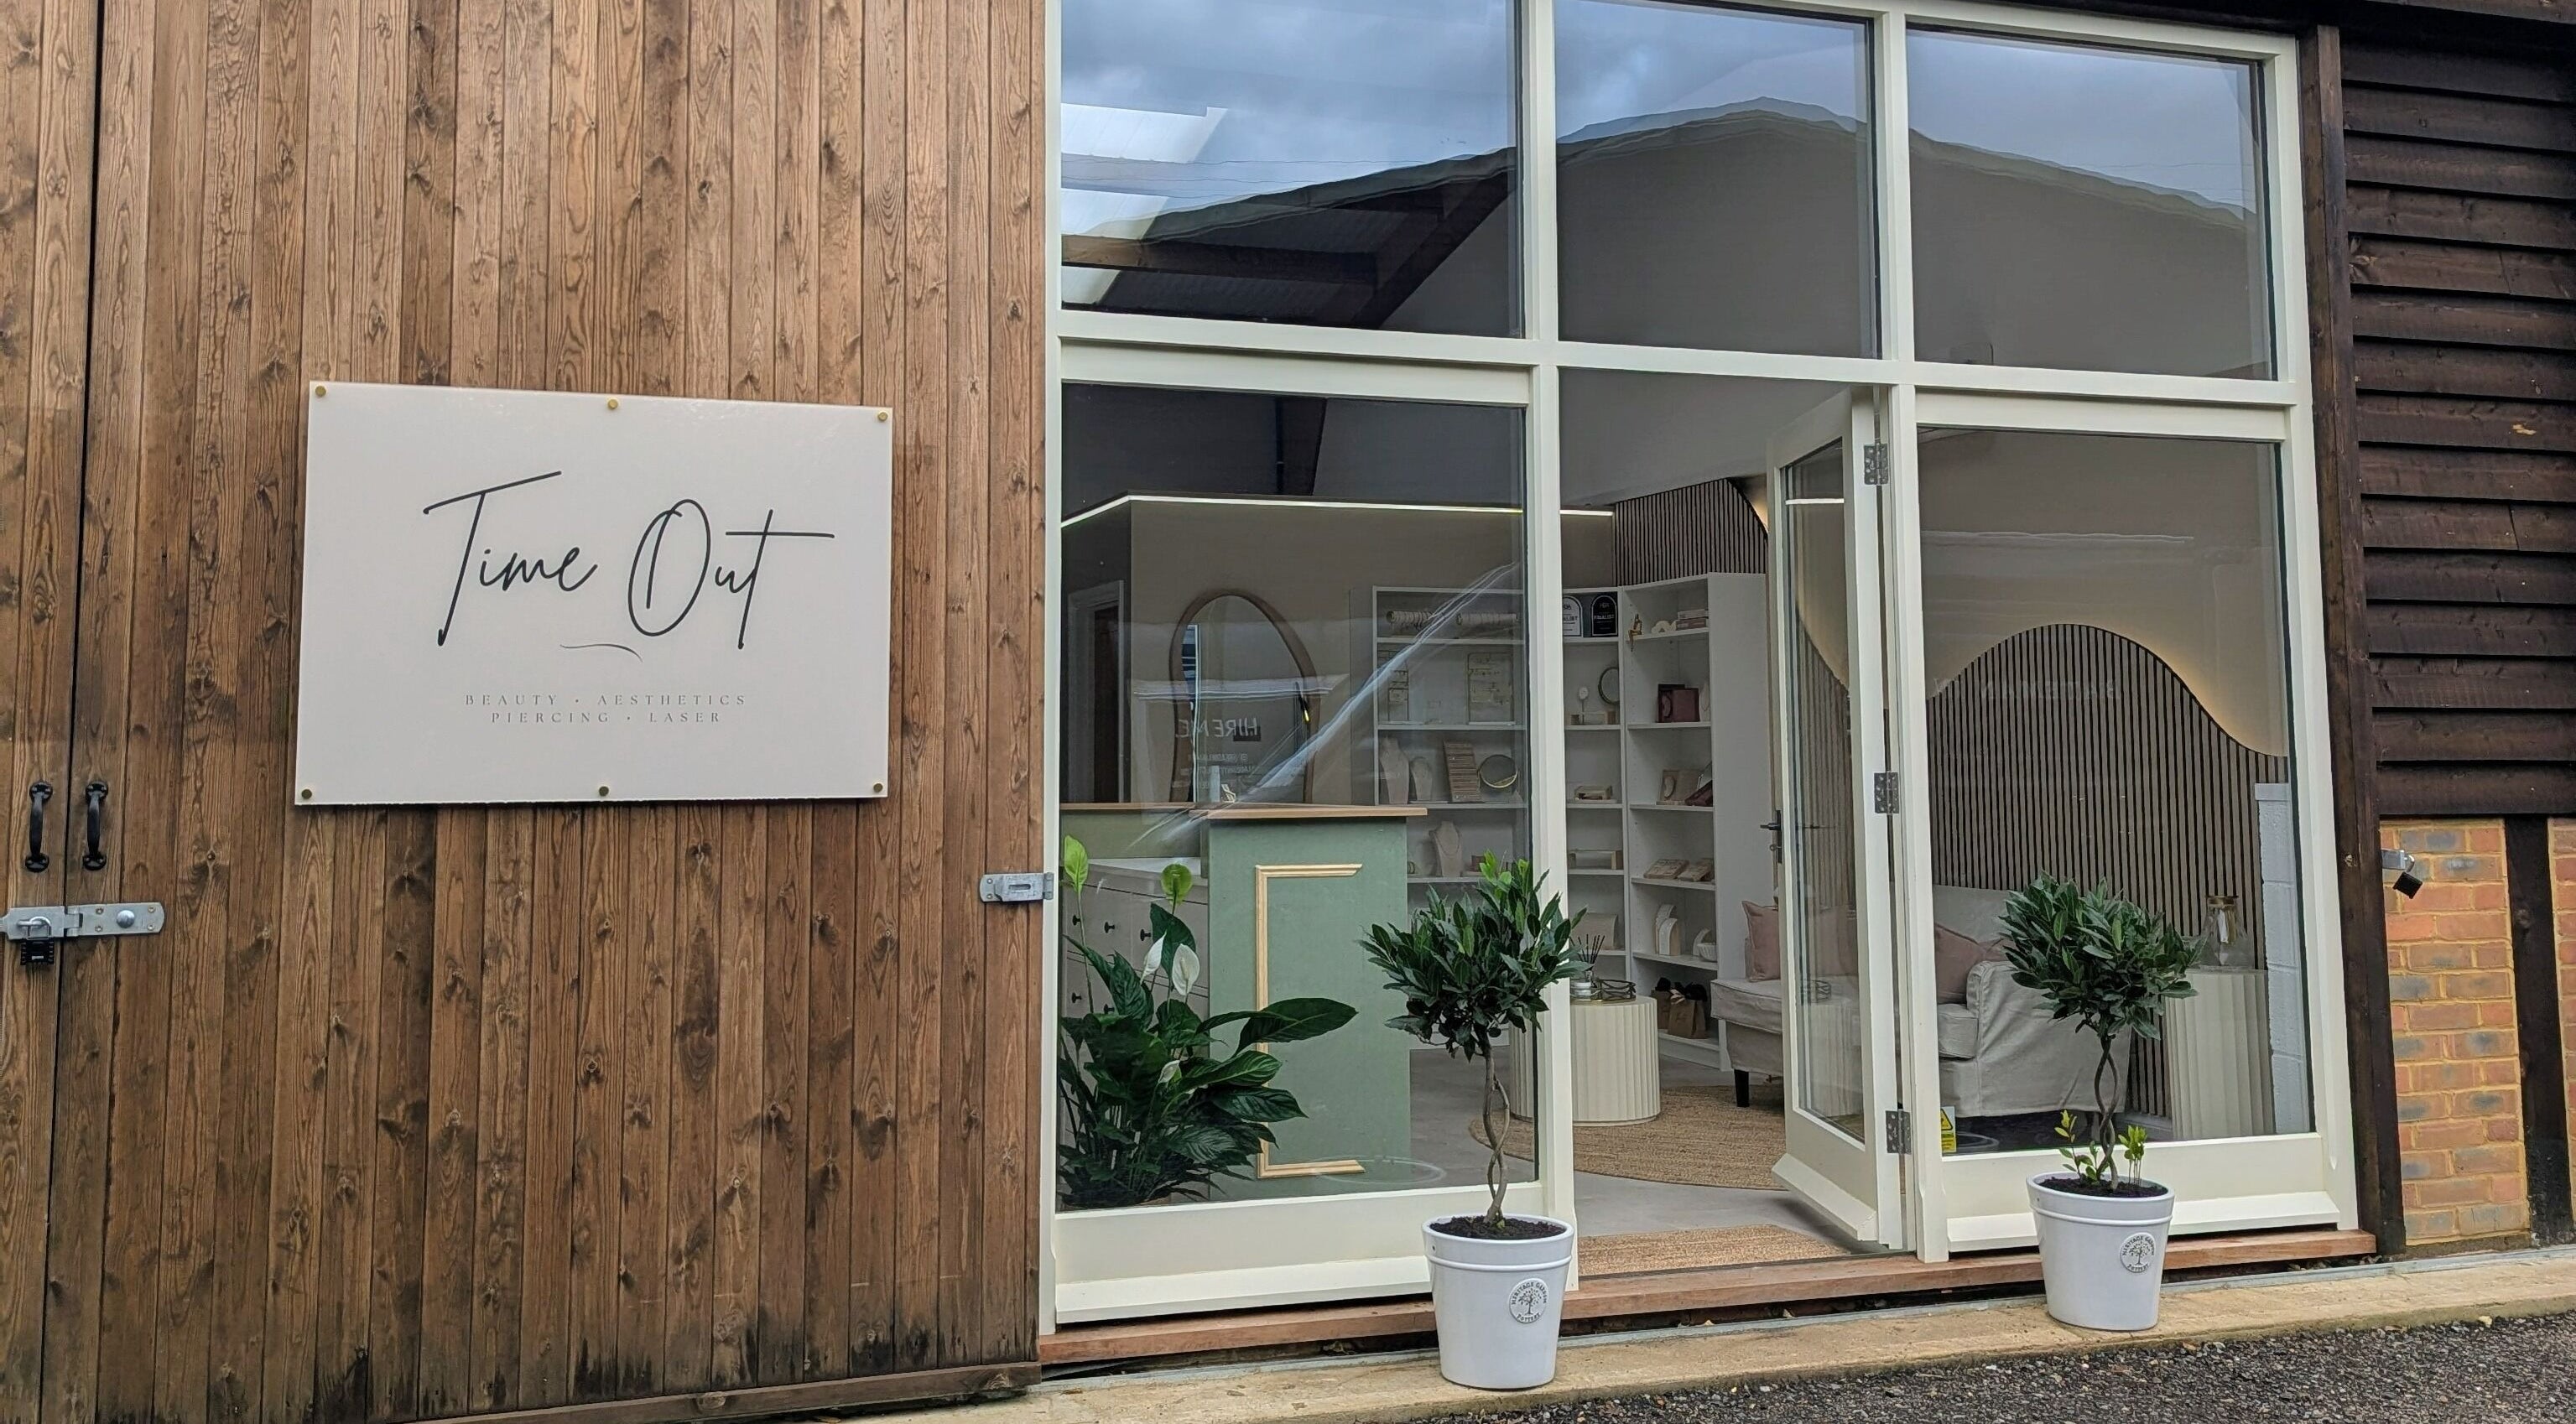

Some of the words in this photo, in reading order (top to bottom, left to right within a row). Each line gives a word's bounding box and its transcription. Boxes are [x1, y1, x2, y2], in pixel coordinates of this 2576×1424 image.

[423, 470, 598, 647] Time
[627, 497, 835, 650] Out
[466, 694, 557, 705] BEAUTY
[597, 694, 745, 705] AESTHETICS
[491, 712, 611, 723] PIERCING
[649, 712, 720, 723] LASER
[1511, 1281, 1534, 1305] HERITAGE
[1517, 1312, 1540, 1322] POTTERY
